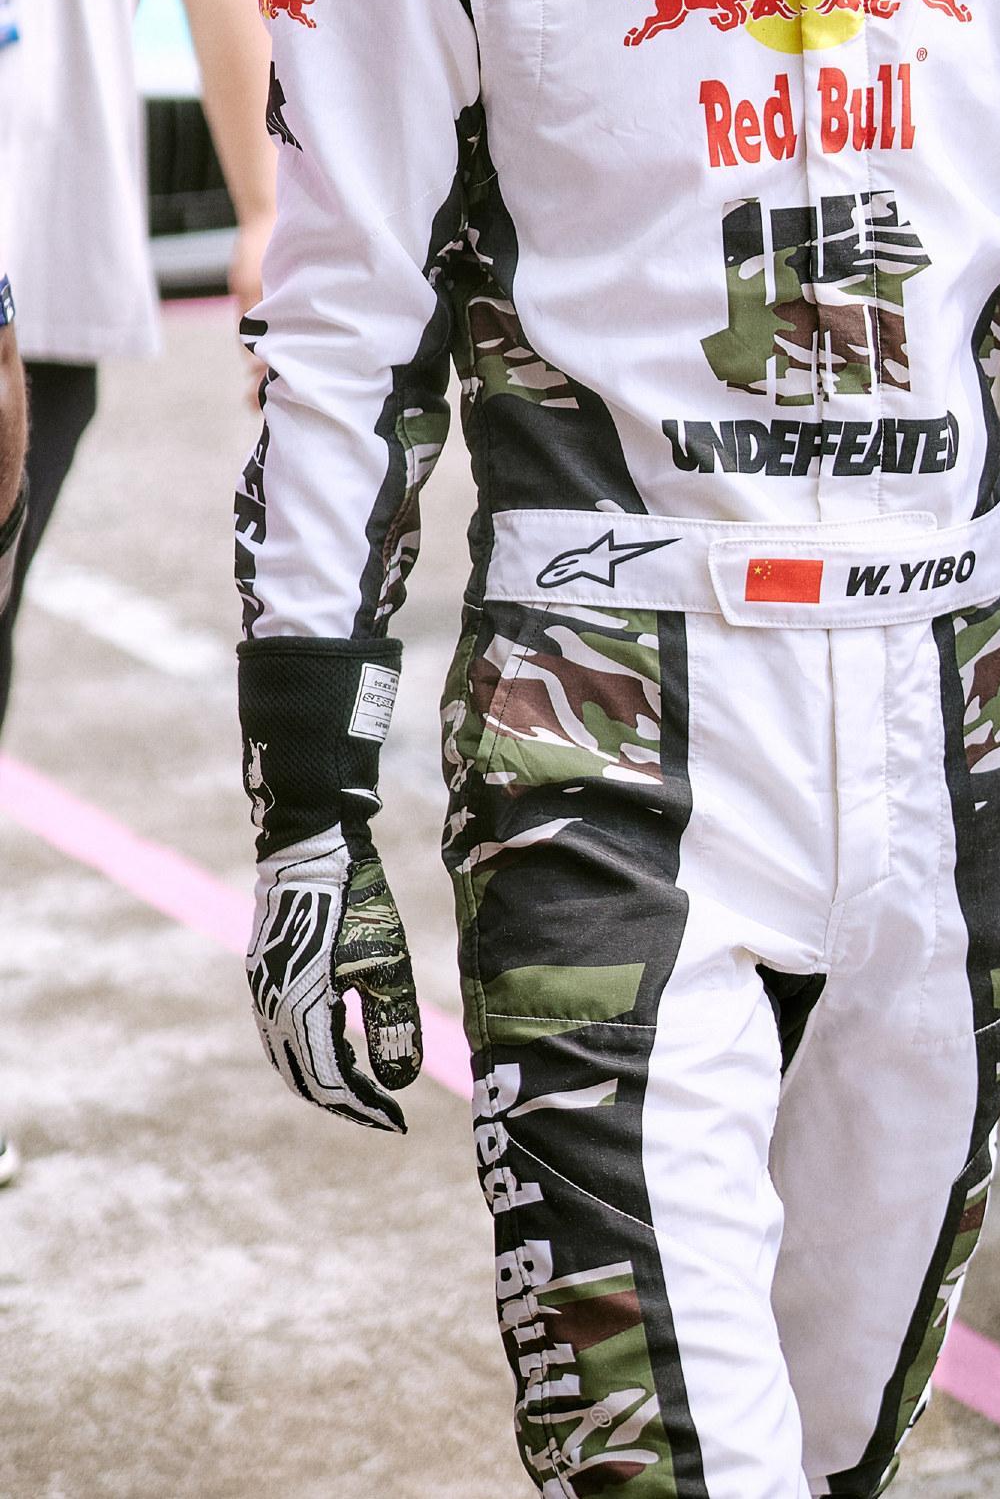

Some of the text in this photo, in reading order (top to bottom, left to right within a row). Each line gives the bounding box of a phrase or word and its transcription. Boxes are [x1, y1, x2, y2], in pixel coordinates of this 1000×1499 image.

[699, 63, 916, 167] Red Bull
[661, 410, 960, 477] UNDEFEATED
